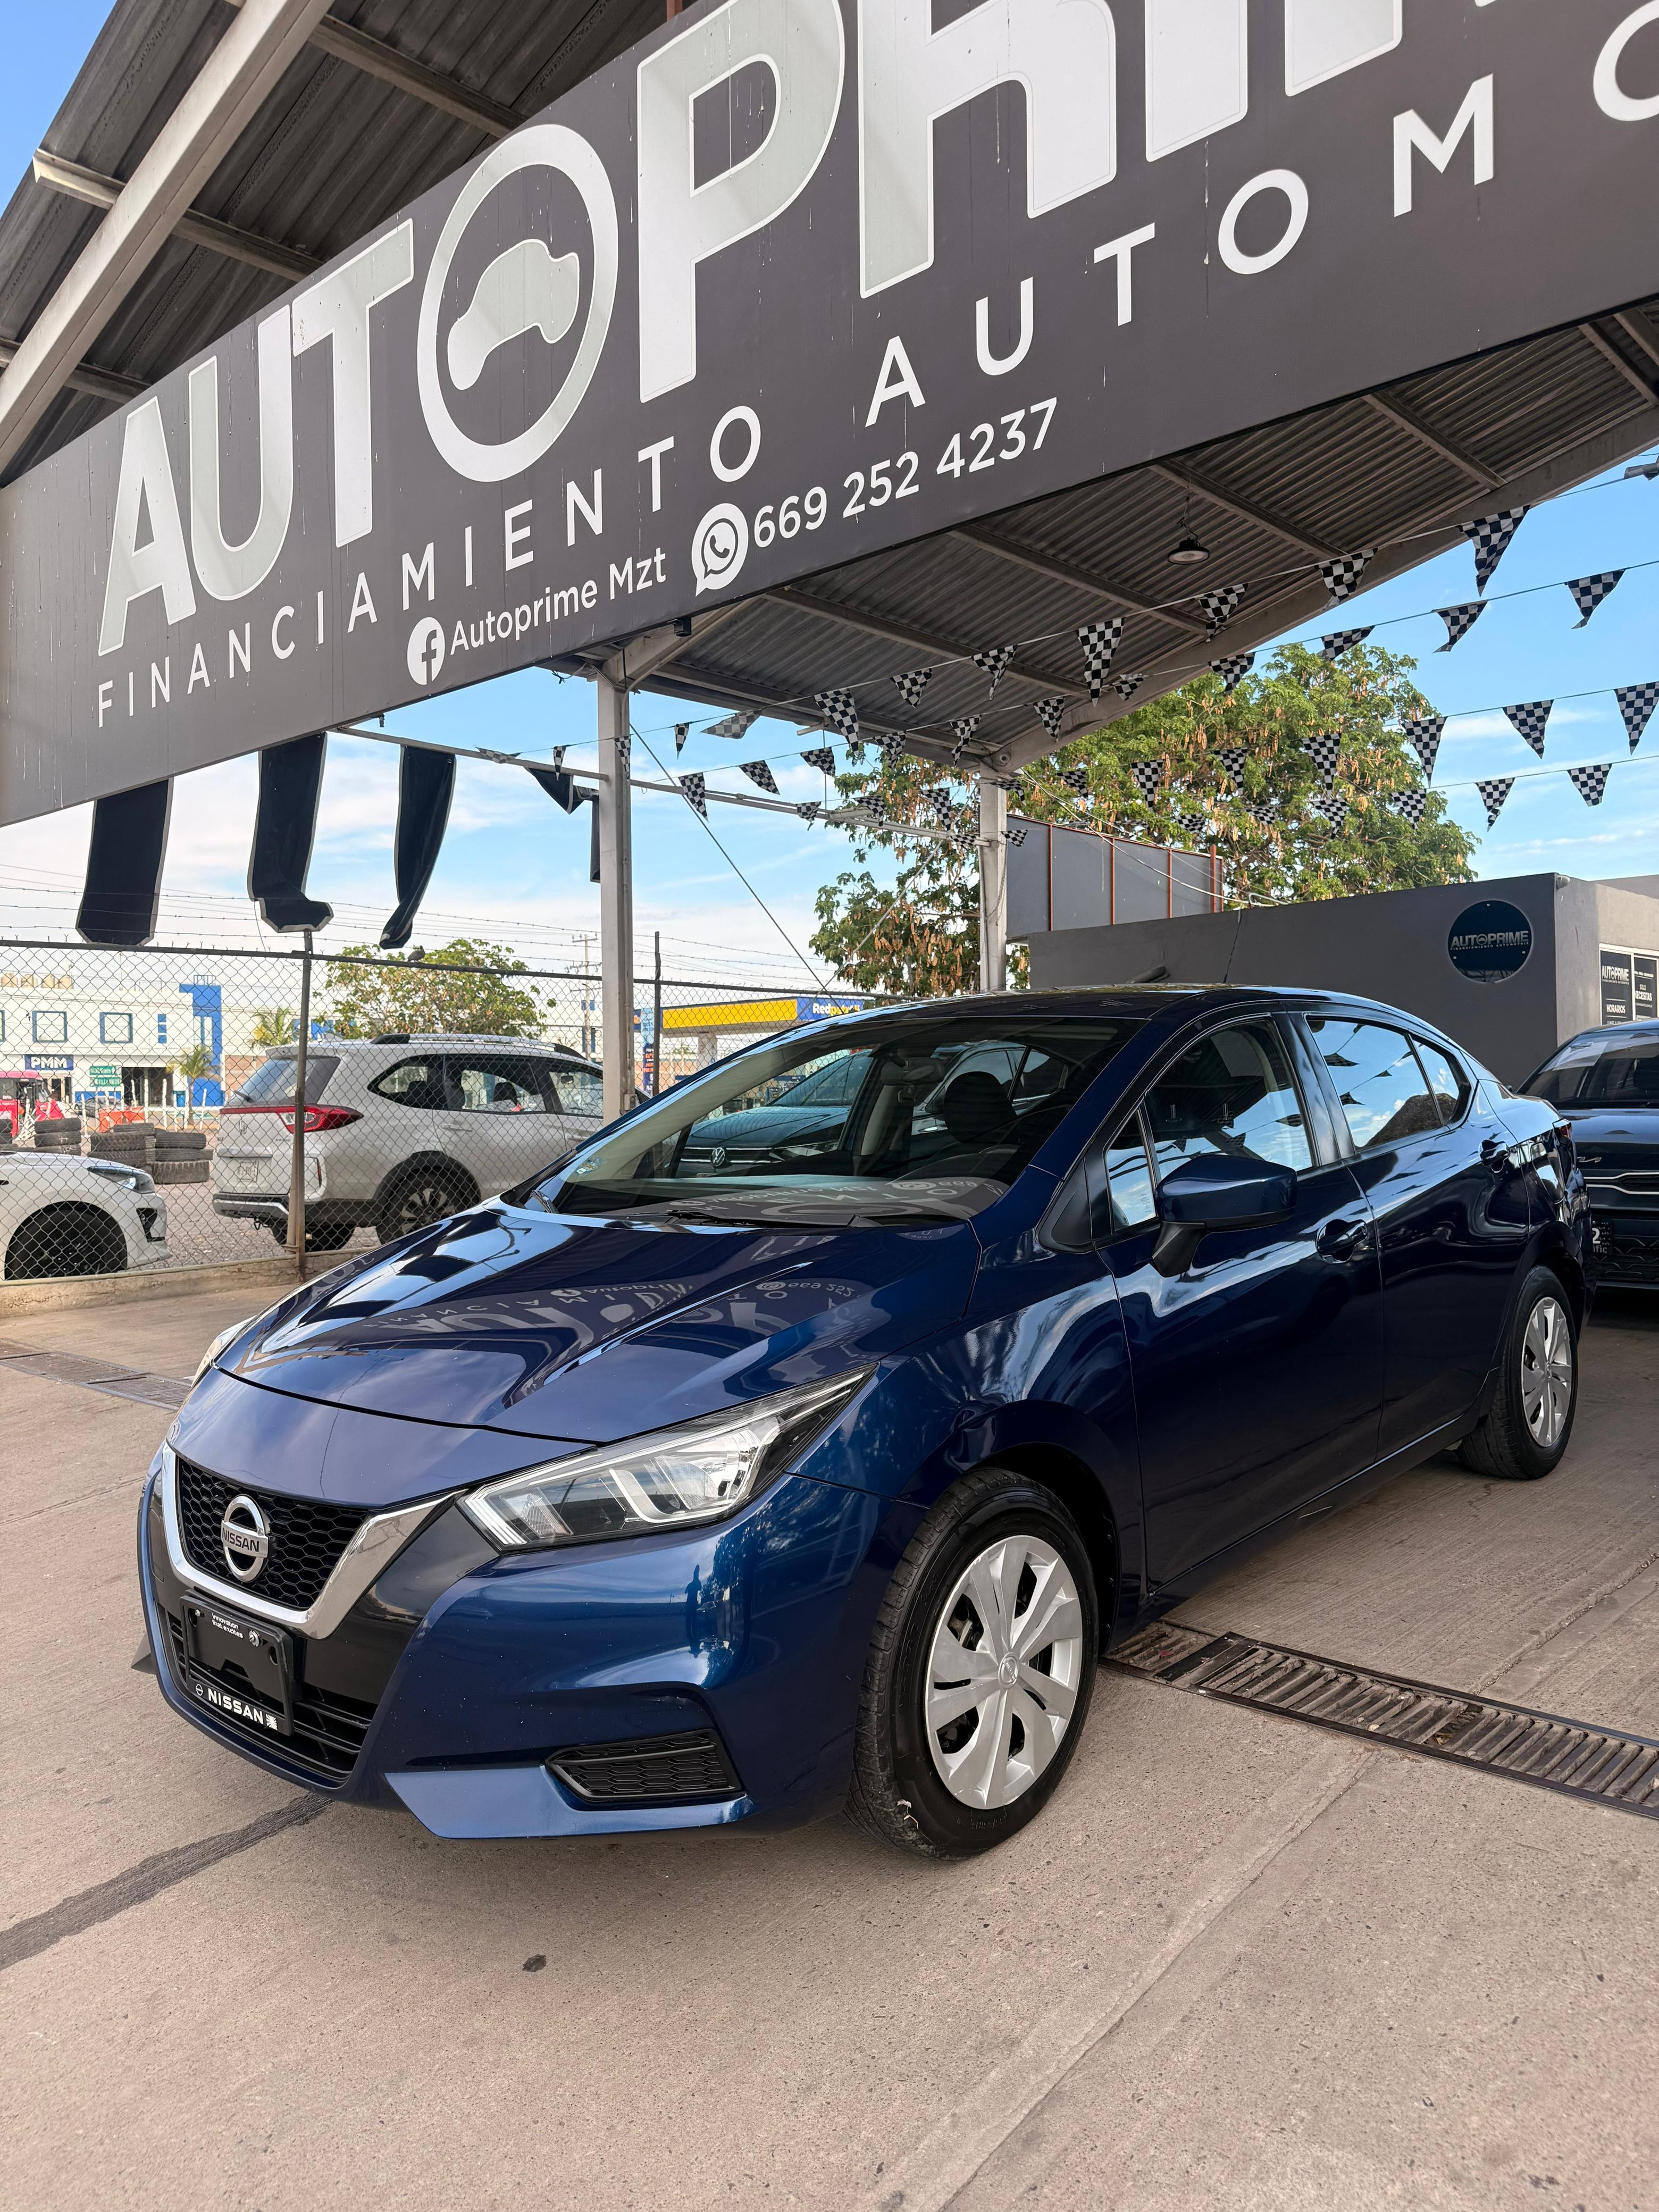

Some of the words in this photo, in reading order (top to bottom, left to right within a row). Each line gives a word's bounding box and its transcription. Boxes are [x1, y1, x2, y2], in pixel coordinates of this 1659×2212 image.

[753, 486, 827, 548] 669
[842, 451, 919, 518] 252
[935, 397, 1057, 479] 4237
[98, 405, 761, 728] FINANCIAMIENTO
[450, 580, 598, 656] Autoprime
[609, 547, 666, 600] Mzt
[1450, 930, 1529, 948] AUTOPRIME
[1601, 965, 1629, 982] AUTOPRIME
[1606, 1004, 1626, 1013] HORARIOS
[31, 1056, 67, 1068] PMM
[221, 1524, 260, 1553] NISSAN
[212, 1619, 223, 1630] that
[223, 1626, 244, 1638] excites
[207, 1688, 264, 1725] NISSAN
